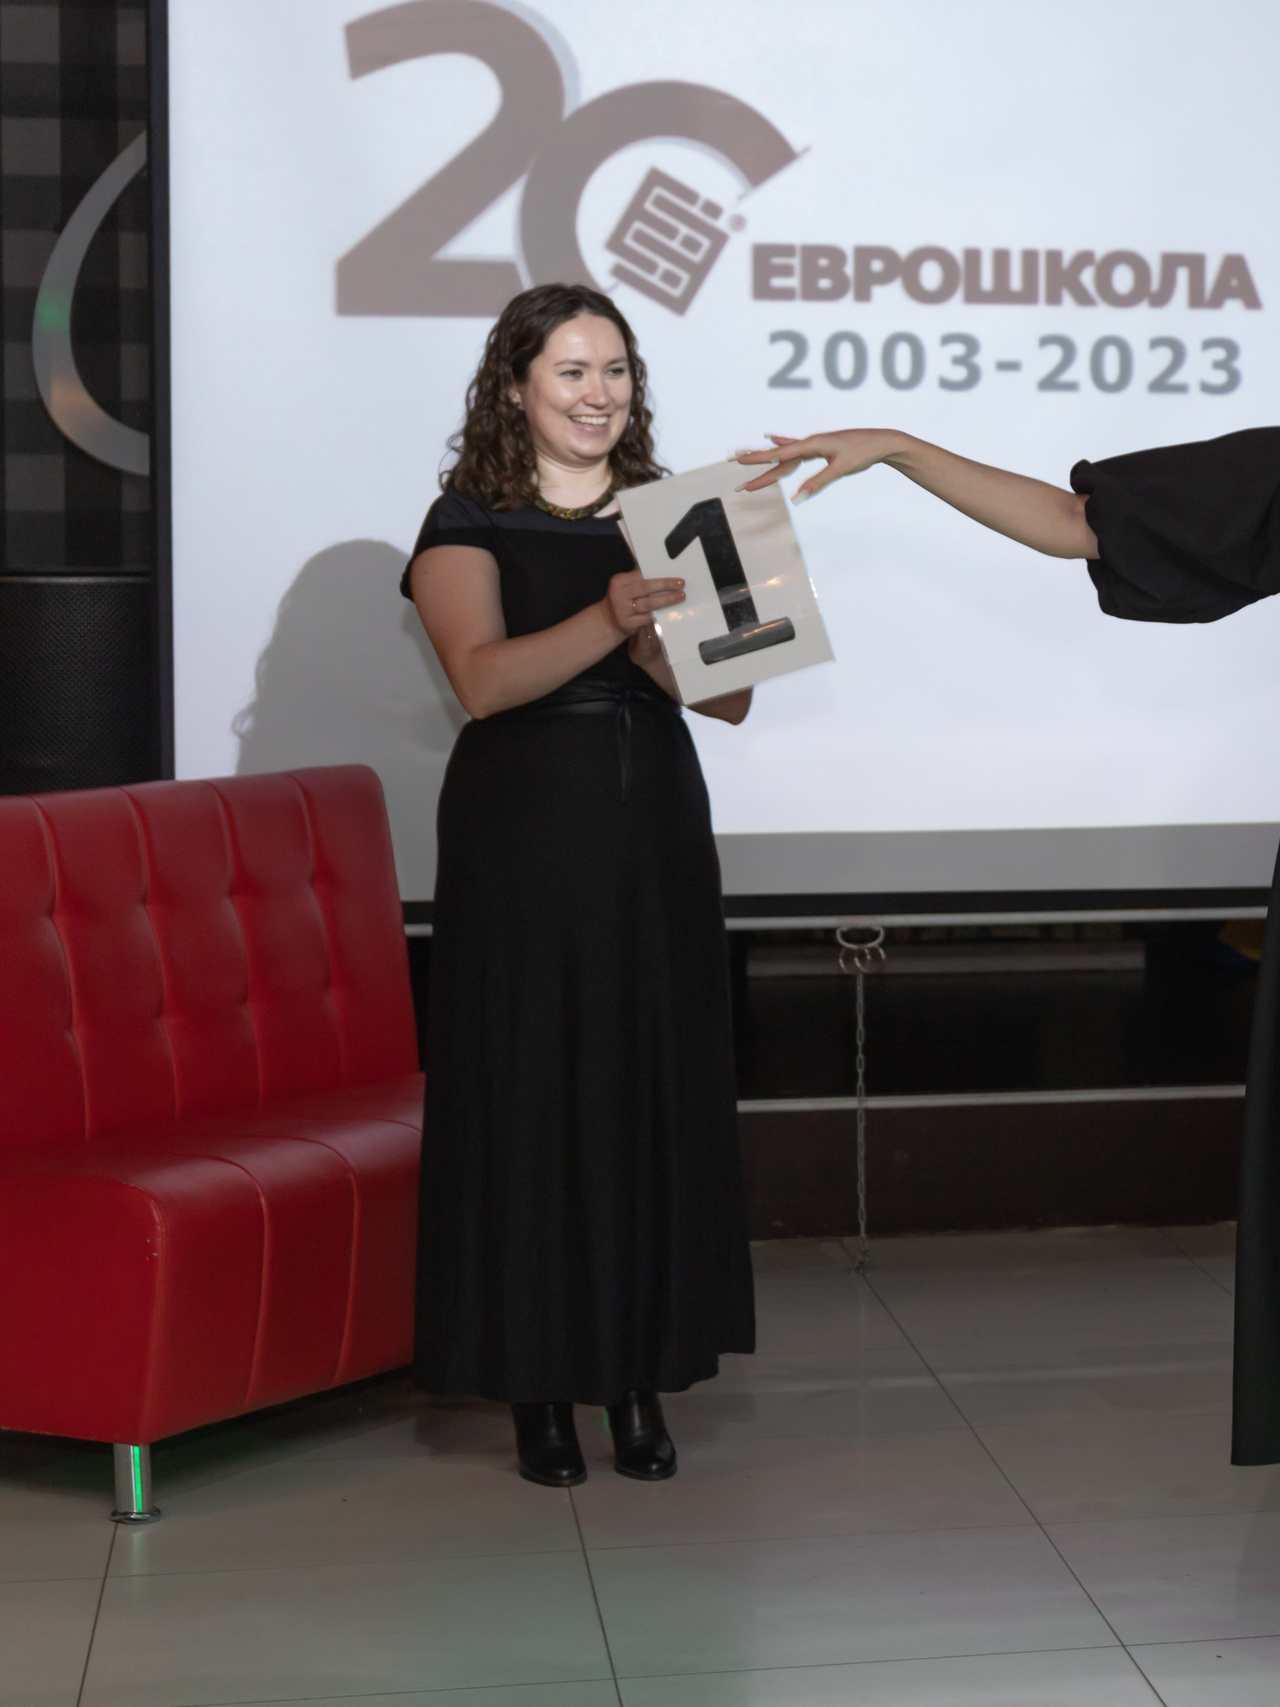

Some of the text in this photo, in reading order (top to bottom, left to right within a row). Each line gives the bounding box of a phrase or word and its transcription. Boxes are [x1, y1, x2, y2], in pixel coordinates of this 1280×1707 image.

[751, 243, 1262, 310] ЕВРОШКОЛА
[766, 330, 1243, 395] 2003-2023
[664, 497, 796, 666] 1
